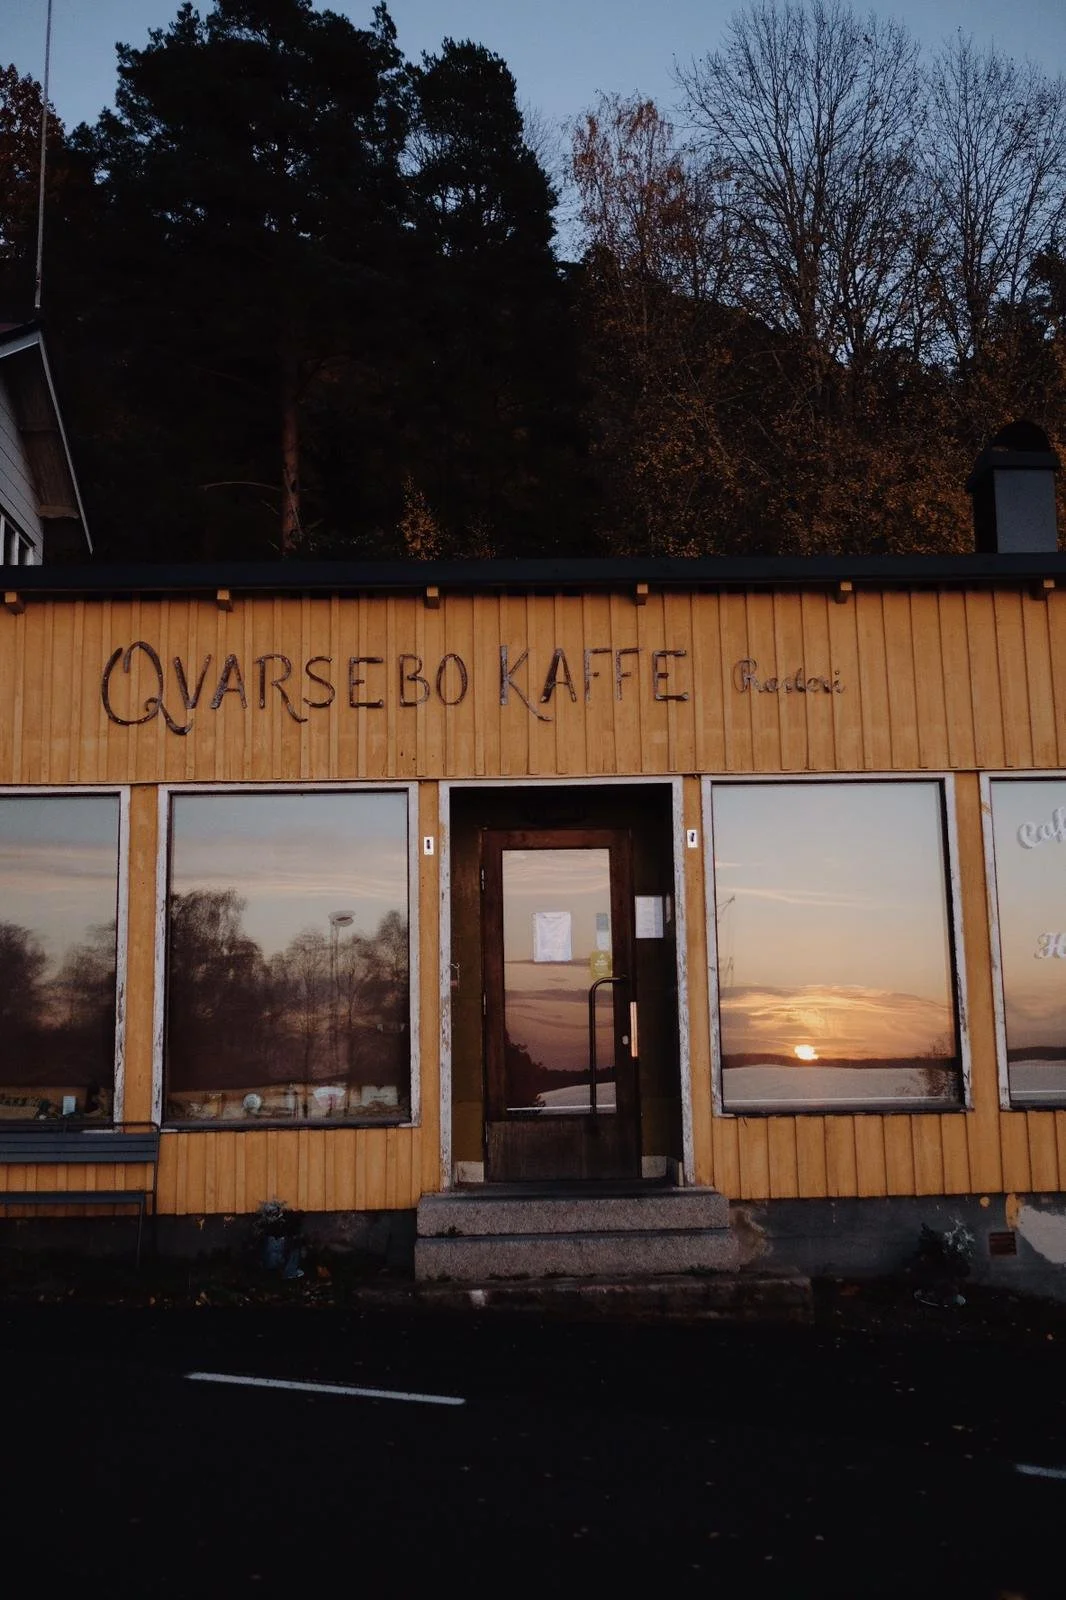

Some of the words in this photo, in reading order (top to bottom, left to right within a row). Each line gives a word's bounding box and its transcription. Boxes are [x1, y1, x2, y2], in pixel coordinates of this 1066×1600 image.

[102, 642, 468, 735] QVARSEBO
[500, 645, 690, 720] KAFFE
[1017, 807, 1066, 849] Caf
